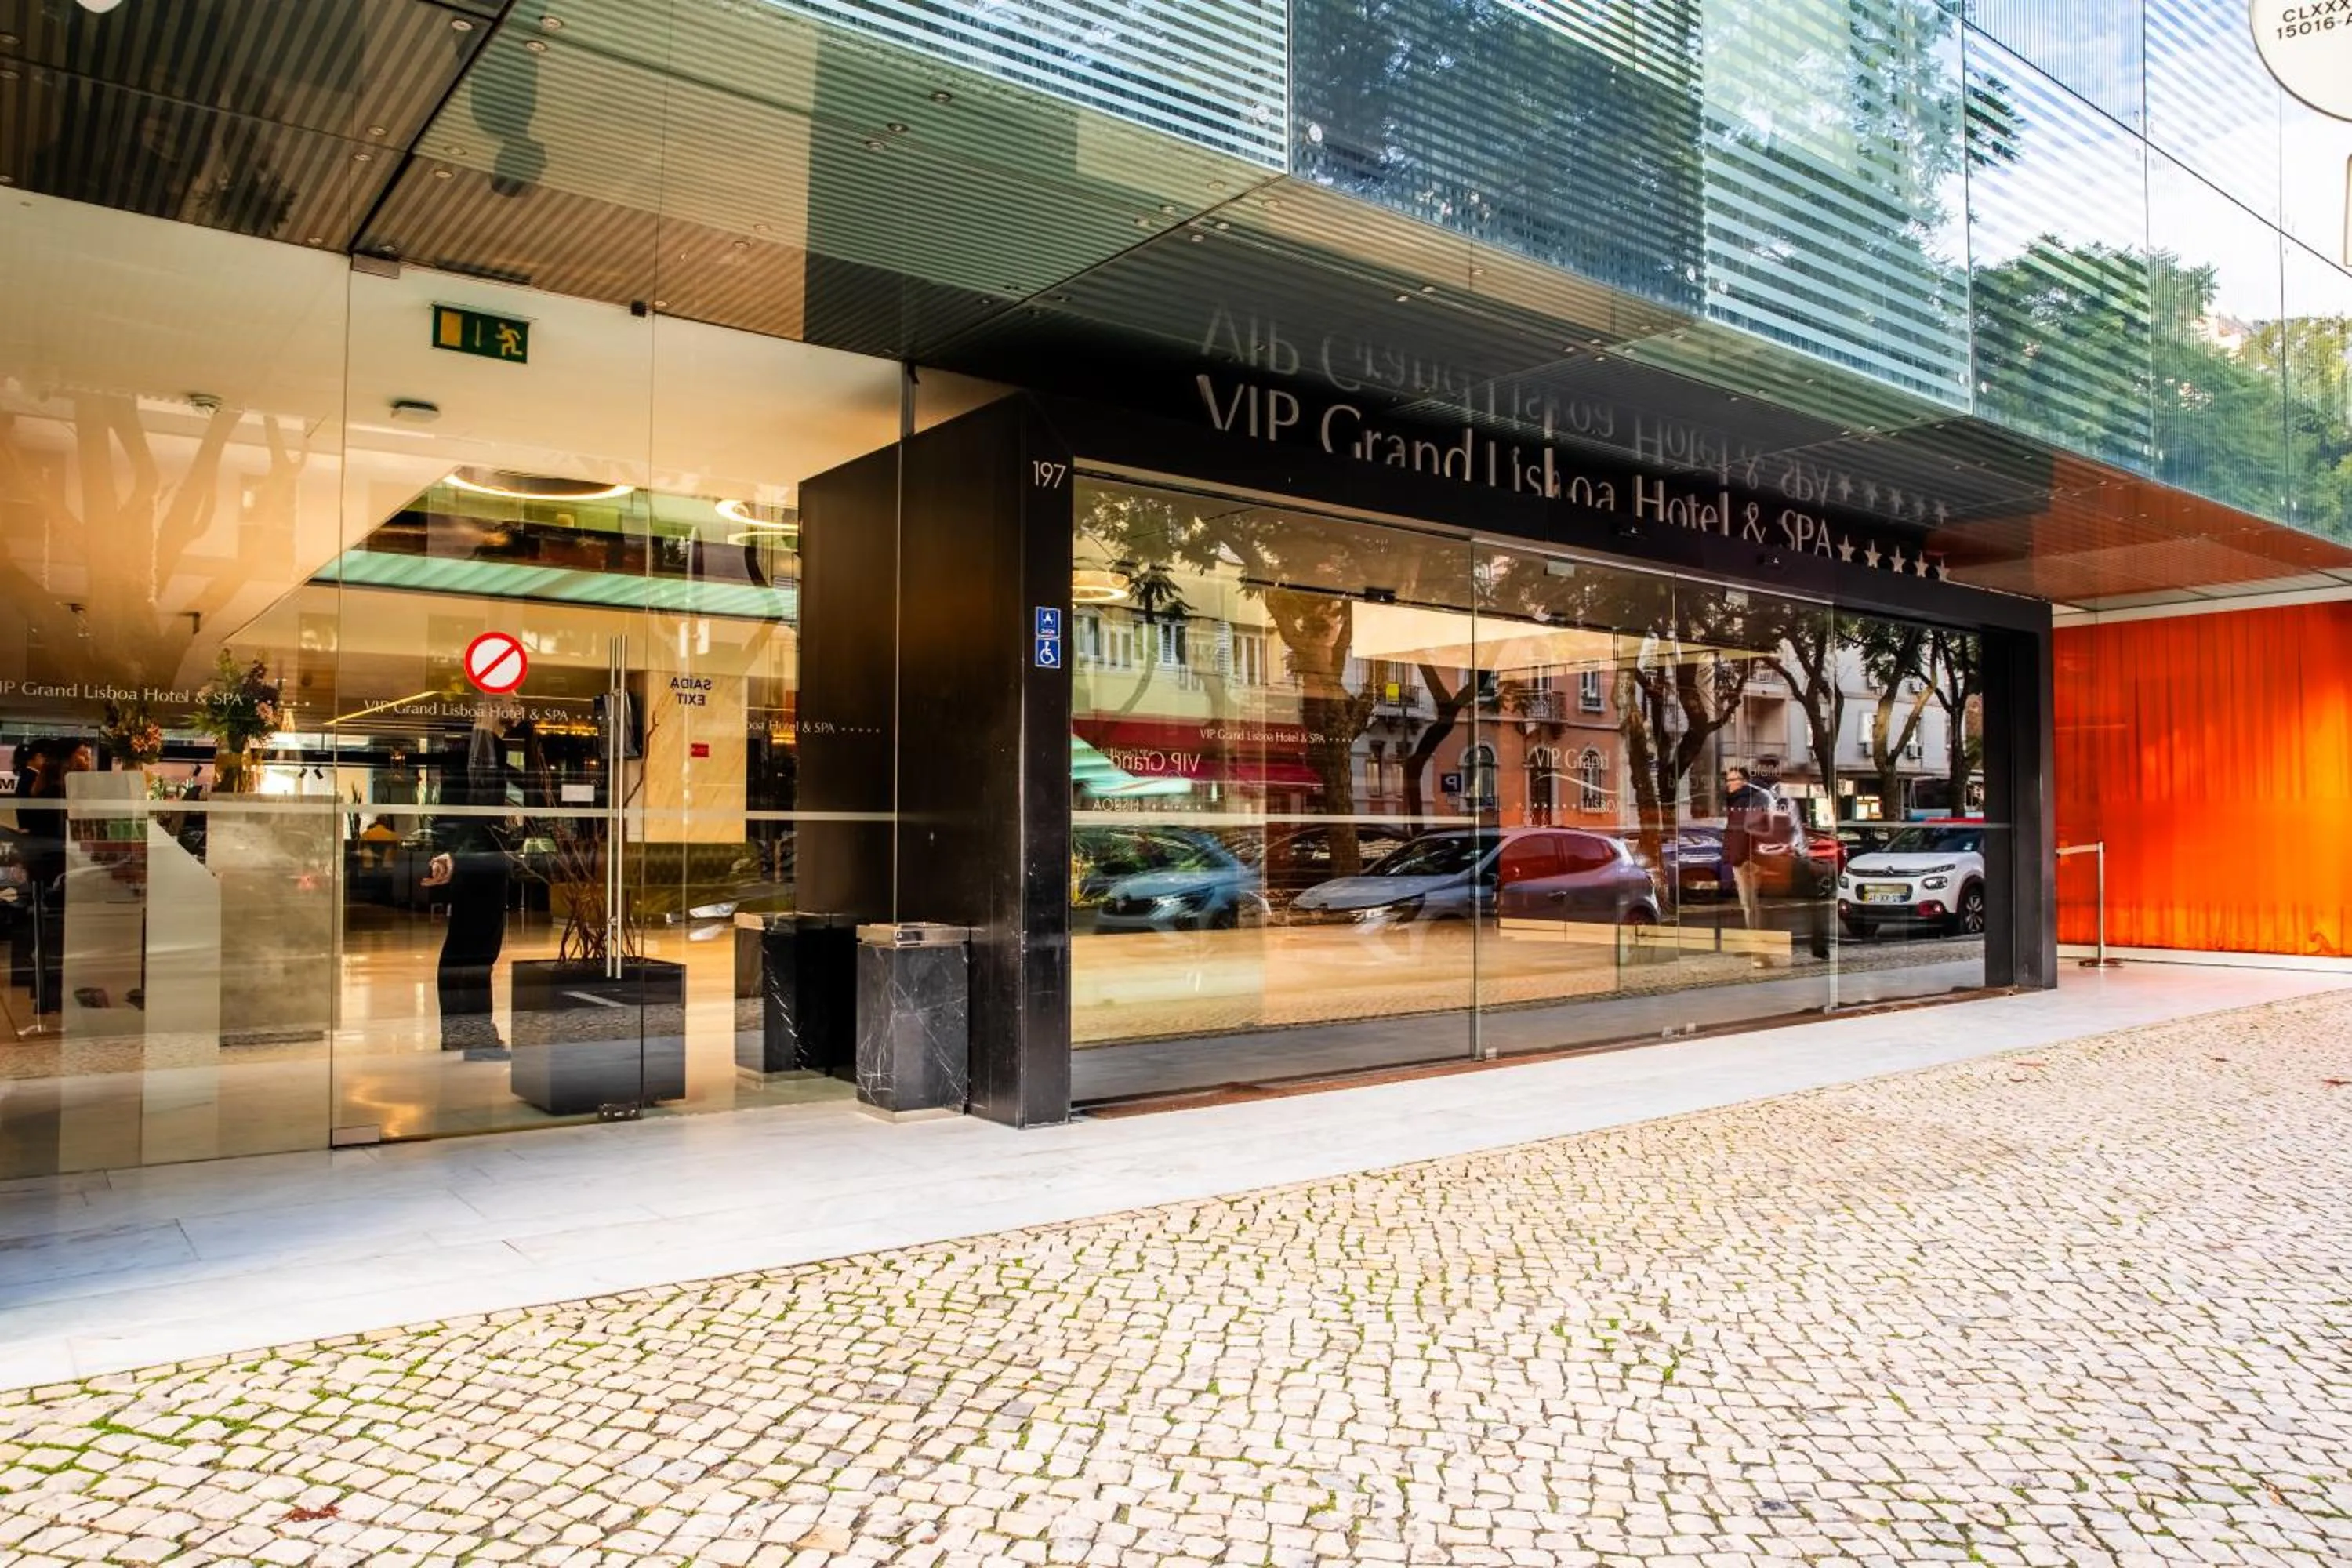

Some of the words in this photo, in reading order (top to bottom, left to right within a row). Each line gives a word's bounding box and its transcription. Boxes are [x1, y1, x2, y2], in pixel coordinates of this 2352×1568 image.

[1033, 460, 1067, 489] 197
[1196, 374, 1300, 441] VIP
[1321, 404, 1473, 482] Grand
[1635, 474, 1730, 536] Hotel
[1743, 501, 1766, 543] &
[1780, 509, 1833, 559] SPA
[0, 680, 16, 695] IP
[22, 681, 78, 698] Grand
[84, 684, 138, 701] Lisboa
[144, 688, 189, 704] Hotel
[196, 690, 208, 704] &
[213, 692, 244, 706] SPA
[365, 699, 389, 713] VIP
[394, 702, 437, 717] Grand
[441, 702, 485, 719] Lisboa
[489, 706, 525, 722] Hotel
[545, 708, 569, 723] SPA
[815, 722, 835, 733] SPA
[1200, 728, 1216, 739] VIP
[1534, 747, 1561, 768] VIP
